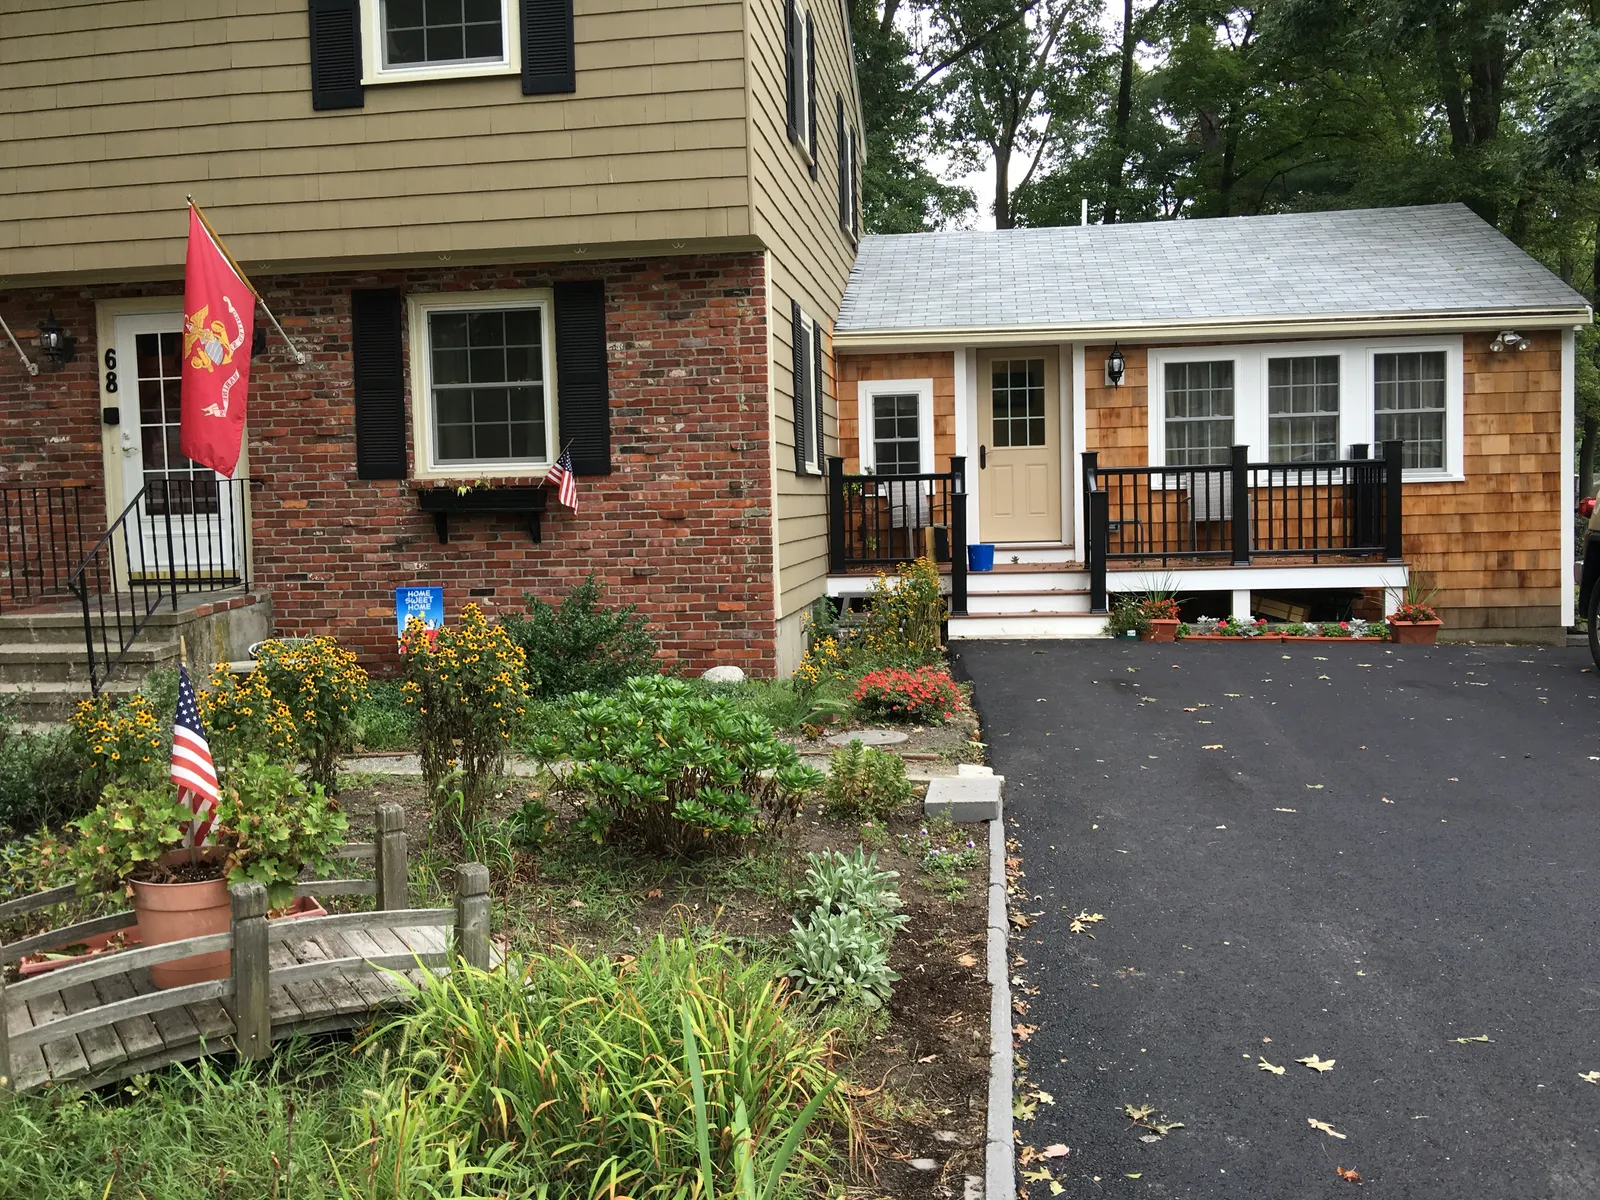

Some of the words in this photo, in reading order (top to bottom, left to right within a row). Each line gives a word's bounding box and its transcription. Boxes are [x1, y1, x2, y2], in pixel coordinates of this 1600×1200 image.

[105, 348, 118, 393] 68
[405, 596, 434, 604] SWEET
[407, 603, 431, 611] HOME
